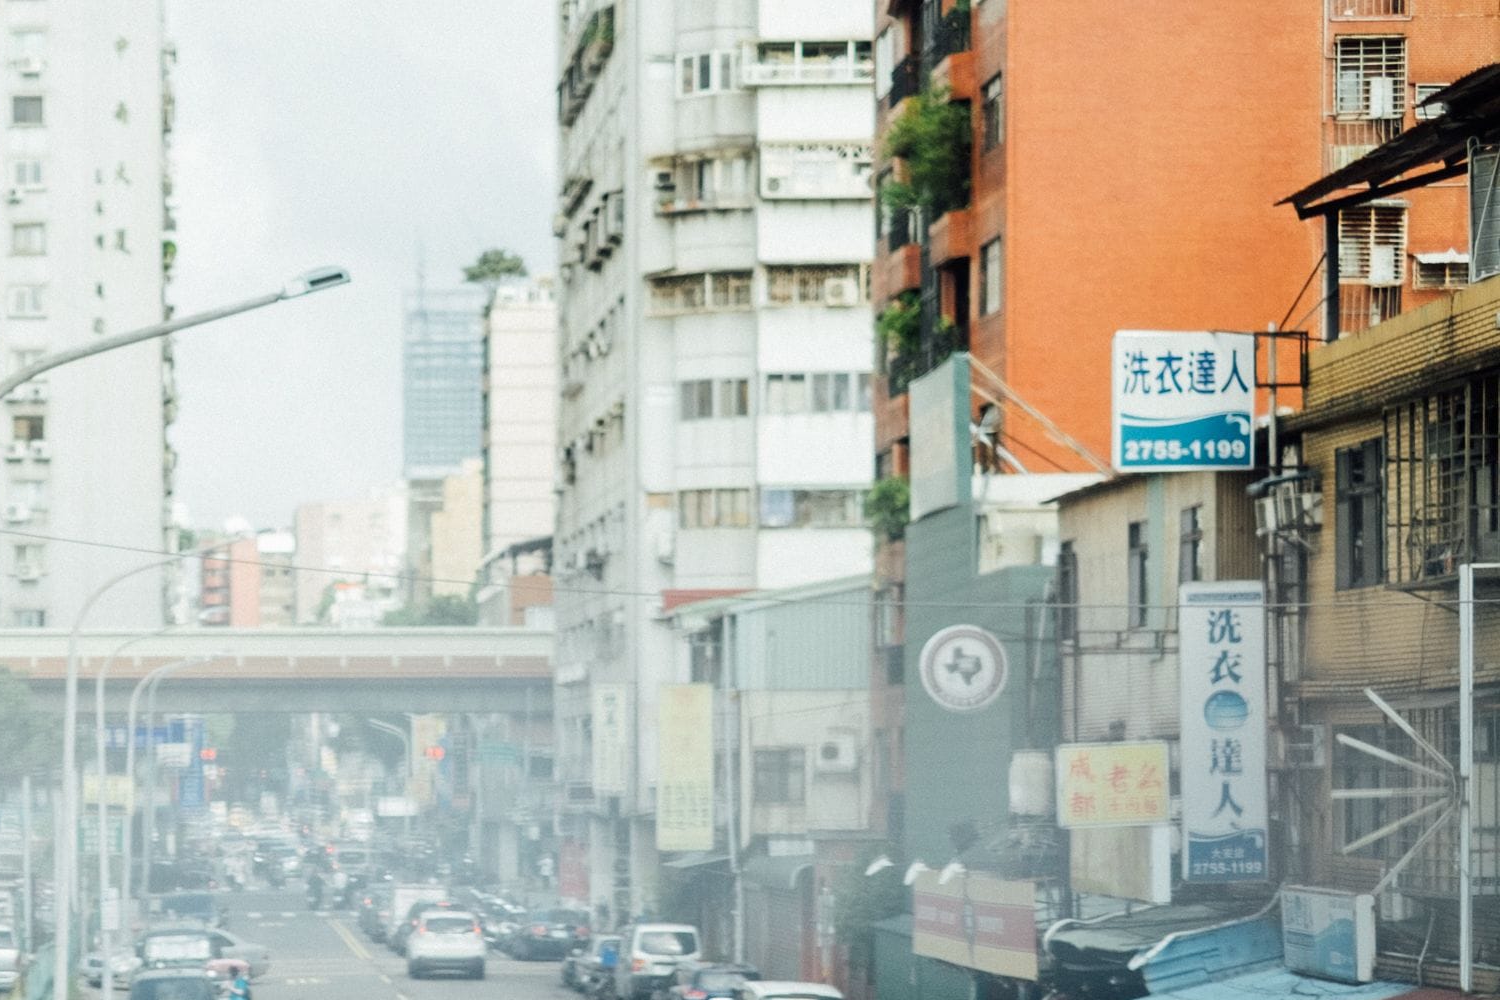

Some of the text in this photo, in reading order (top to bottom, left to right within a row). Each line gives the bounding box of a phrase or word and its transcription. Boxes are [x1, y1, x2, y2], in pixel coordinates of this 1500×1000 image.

[1122, 348, 1249, 397] 洗衣達人
[1124, 439, 1246, 461] 2755-1199
[1206, 609, 1245, 820] 洗衣達人
[1192, 861, 1262, 875] 2755-1199
